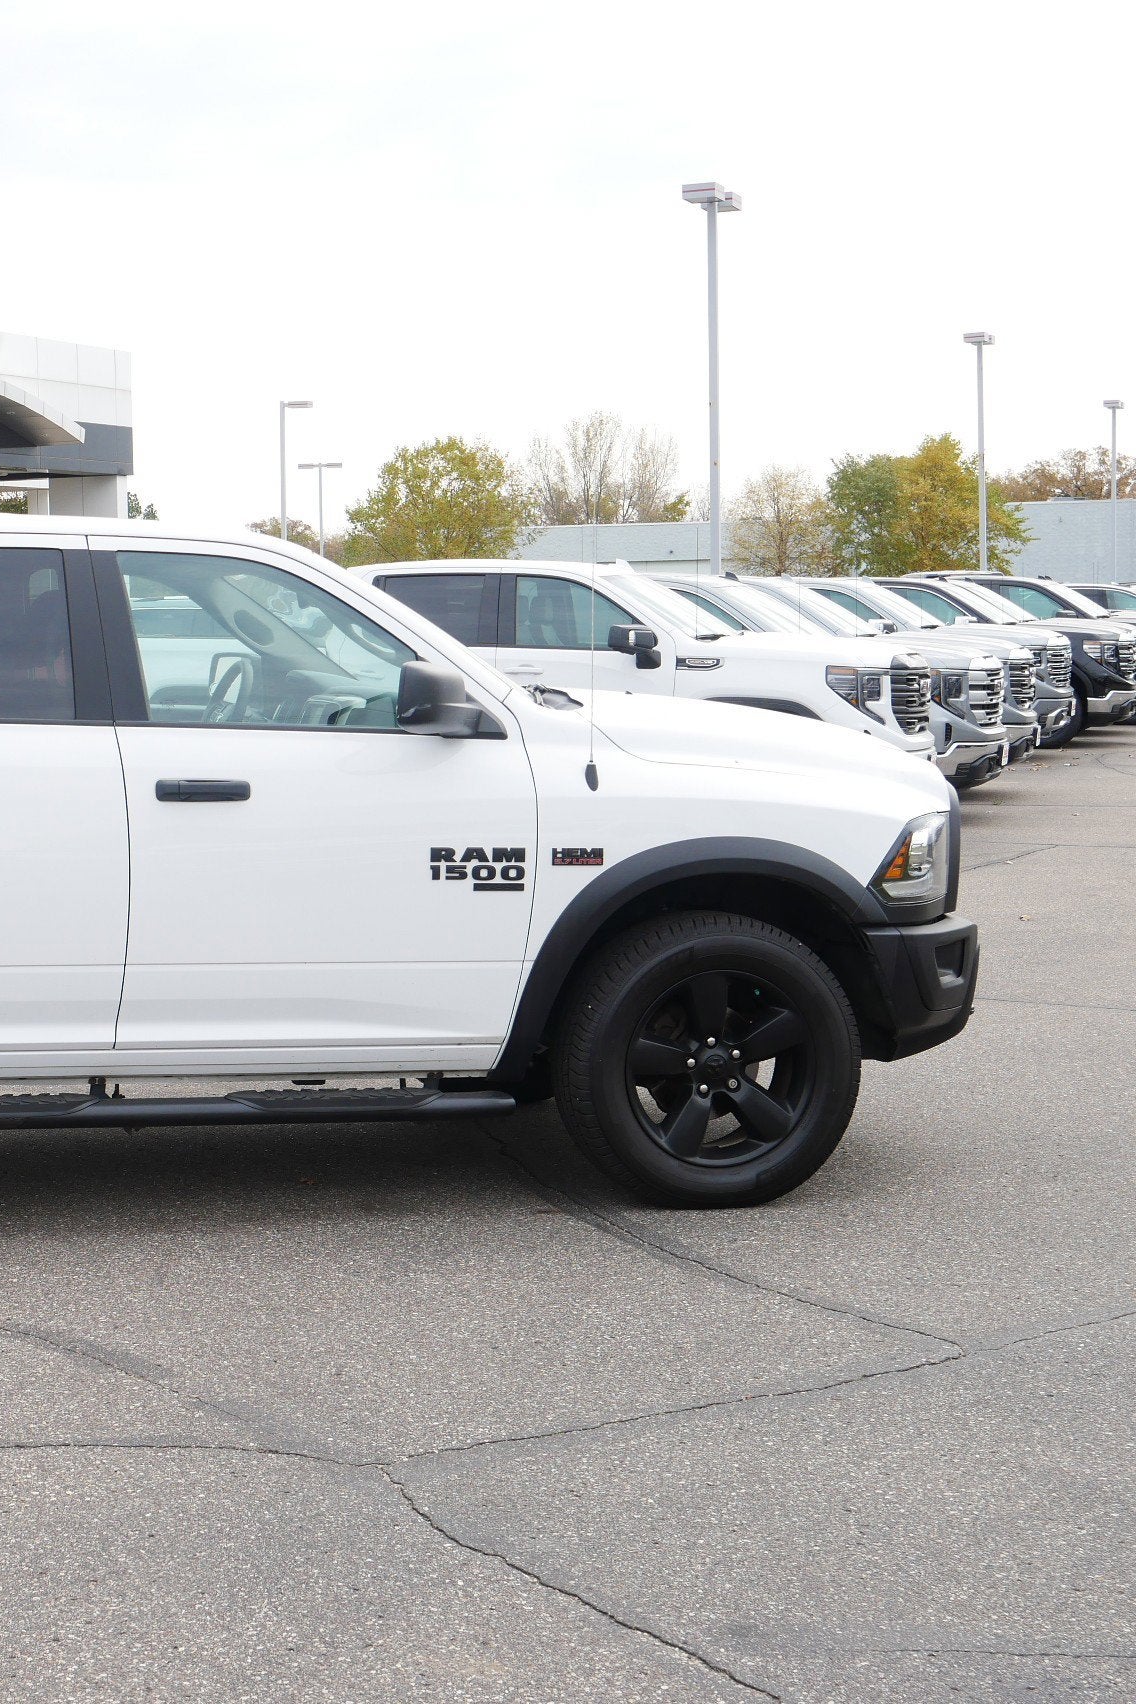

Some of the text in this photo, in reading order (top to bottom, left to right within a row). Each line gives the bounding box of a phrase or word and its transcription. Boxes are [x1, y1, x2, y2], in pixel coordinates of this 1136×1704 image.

[430, 847, 526, 863] RAM
[551, 847, 604, 858] HEMI
[429, 864, 526, 881] 1500
